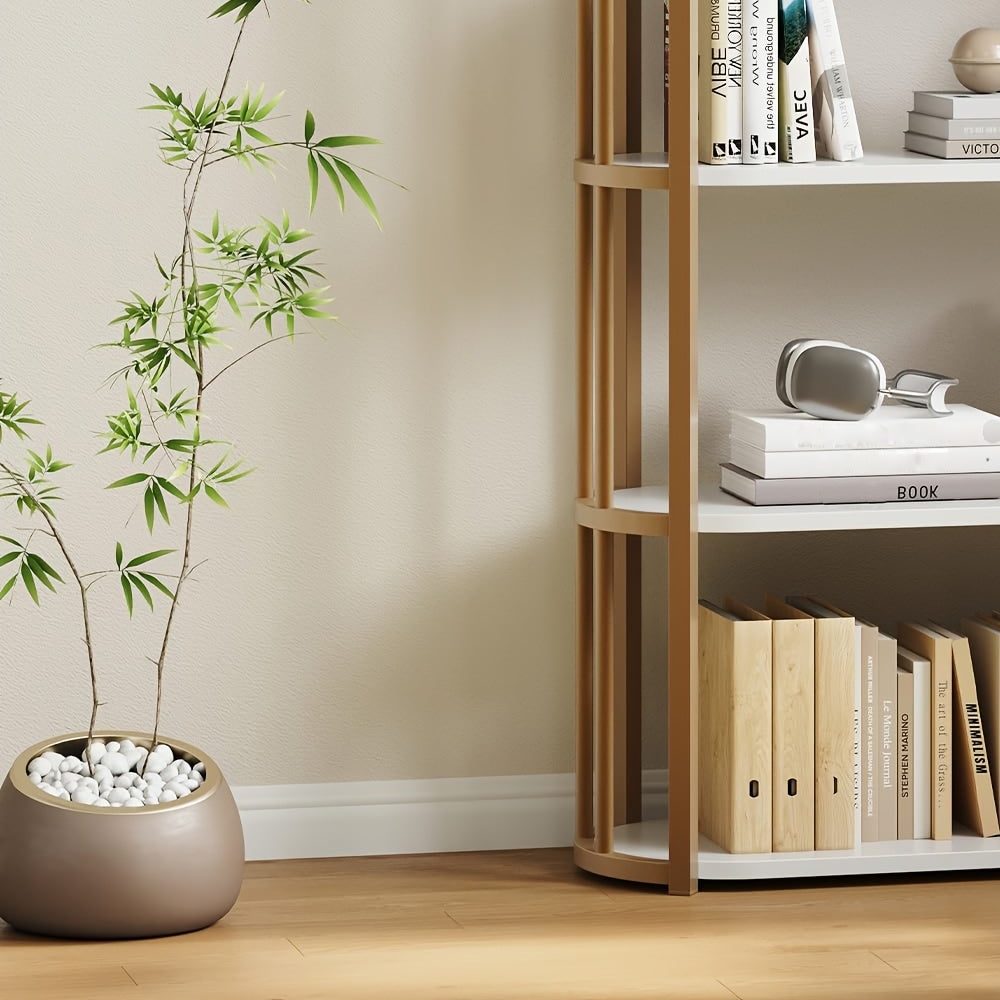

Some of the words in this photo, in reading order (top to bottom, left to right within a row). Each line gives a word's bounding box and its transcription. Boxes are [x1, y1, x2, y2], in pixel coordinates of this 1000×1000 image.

[897, 485, 939, 500] BOOK
[938, 681, 947, 697] The
[883, 700, 892, 712] Le
[938, 704, 947, 718] art
[883, 715, 892, 749] Monde
[938, 726, 947, 736] of
[965, 703, 987, 774] MINIMALISM
[938, 744, 947, 759] the
[883, 752, 892, 788] Journal
